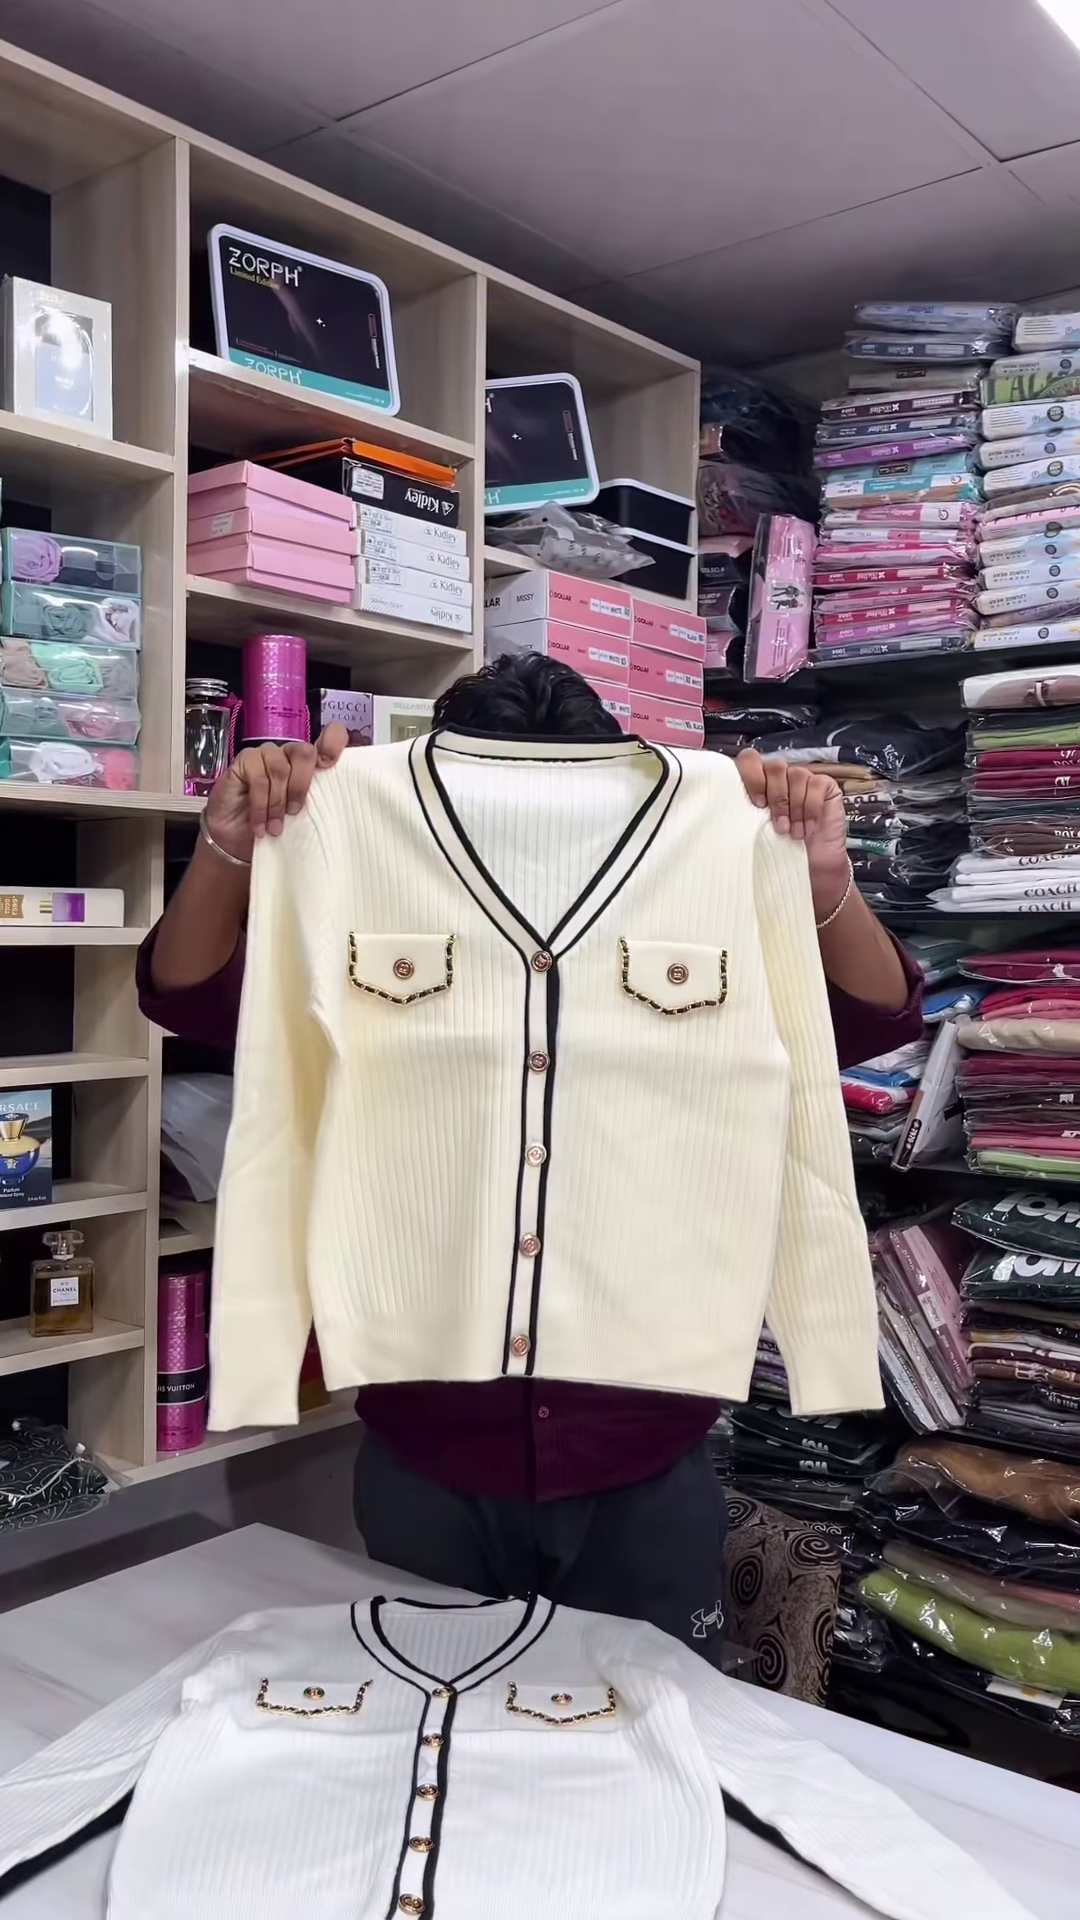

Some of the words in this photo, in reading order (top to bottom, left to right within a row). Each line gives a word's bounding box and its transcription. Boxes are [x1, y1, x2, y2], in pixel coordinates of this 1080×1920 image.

[229, 246, 299, 287] ZORPH
[405, 488, 439, 513] Kidley
[554, 592, 572, 601] DOLLAR
[552, 642, 570, 651] DOLLAR
[633, 664, 650, 673] DOLLAR
[328, 700, 367, 713] GUCCI
[331, 713, 363, 722] FLORA
[1024, 883, 1078, 898] COACH
[167, 1383, 195, 1392] VUITTON
